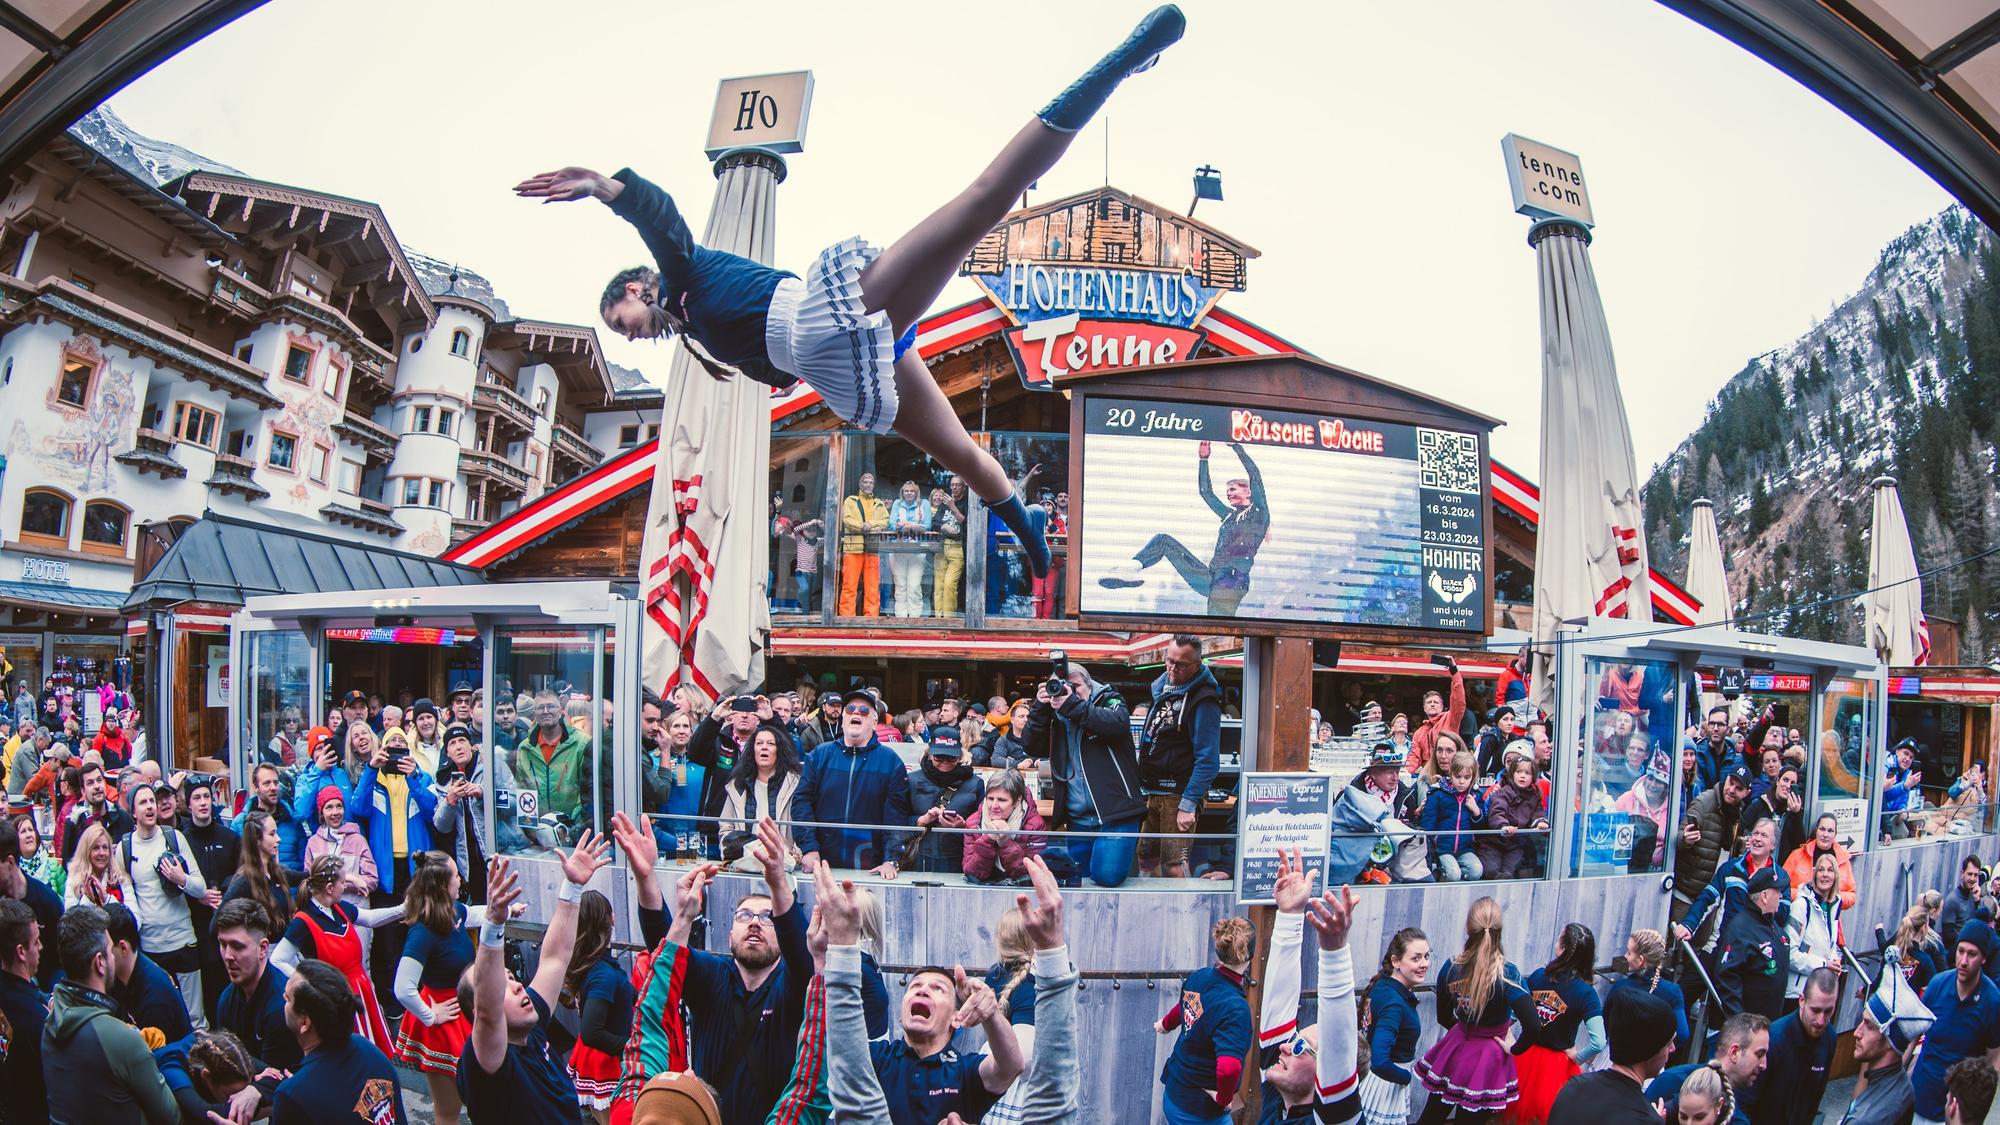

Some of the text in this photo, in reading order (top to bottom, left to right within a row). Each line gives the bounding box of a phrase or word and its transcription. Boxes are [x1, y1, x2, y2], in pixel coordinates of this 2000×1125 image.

[1520, 151, 1581, 186] tenne
[1532, 181, 1581, 206] .com
[1006, 258, 1198, 319] HOHENHAUS
[1022, 312, 1178, 385] Tenne
[1105, 408, 1203, 433] 20 Jahre
[1230, 410, 1384, 452] KÖLSCHE WOCHE
[1439, 494, 1462, 503] vom
[1426, 504, 1475, 518] 16.3.2024
[1441, 519, 1458, 529] bis
[1423, 530, 1479, 544] 23.03.2024
[22, 558, 70, 582] HOTEL
[1433, 606, 1473, 616] und viele
[1726, 675, 1738, 687] WC
[1248, 783, 1288, 802] HOHENHAUS
[1292, 784, 1324, 797] Express
[1285, 822, 1323, 831] Hotelshuttle
